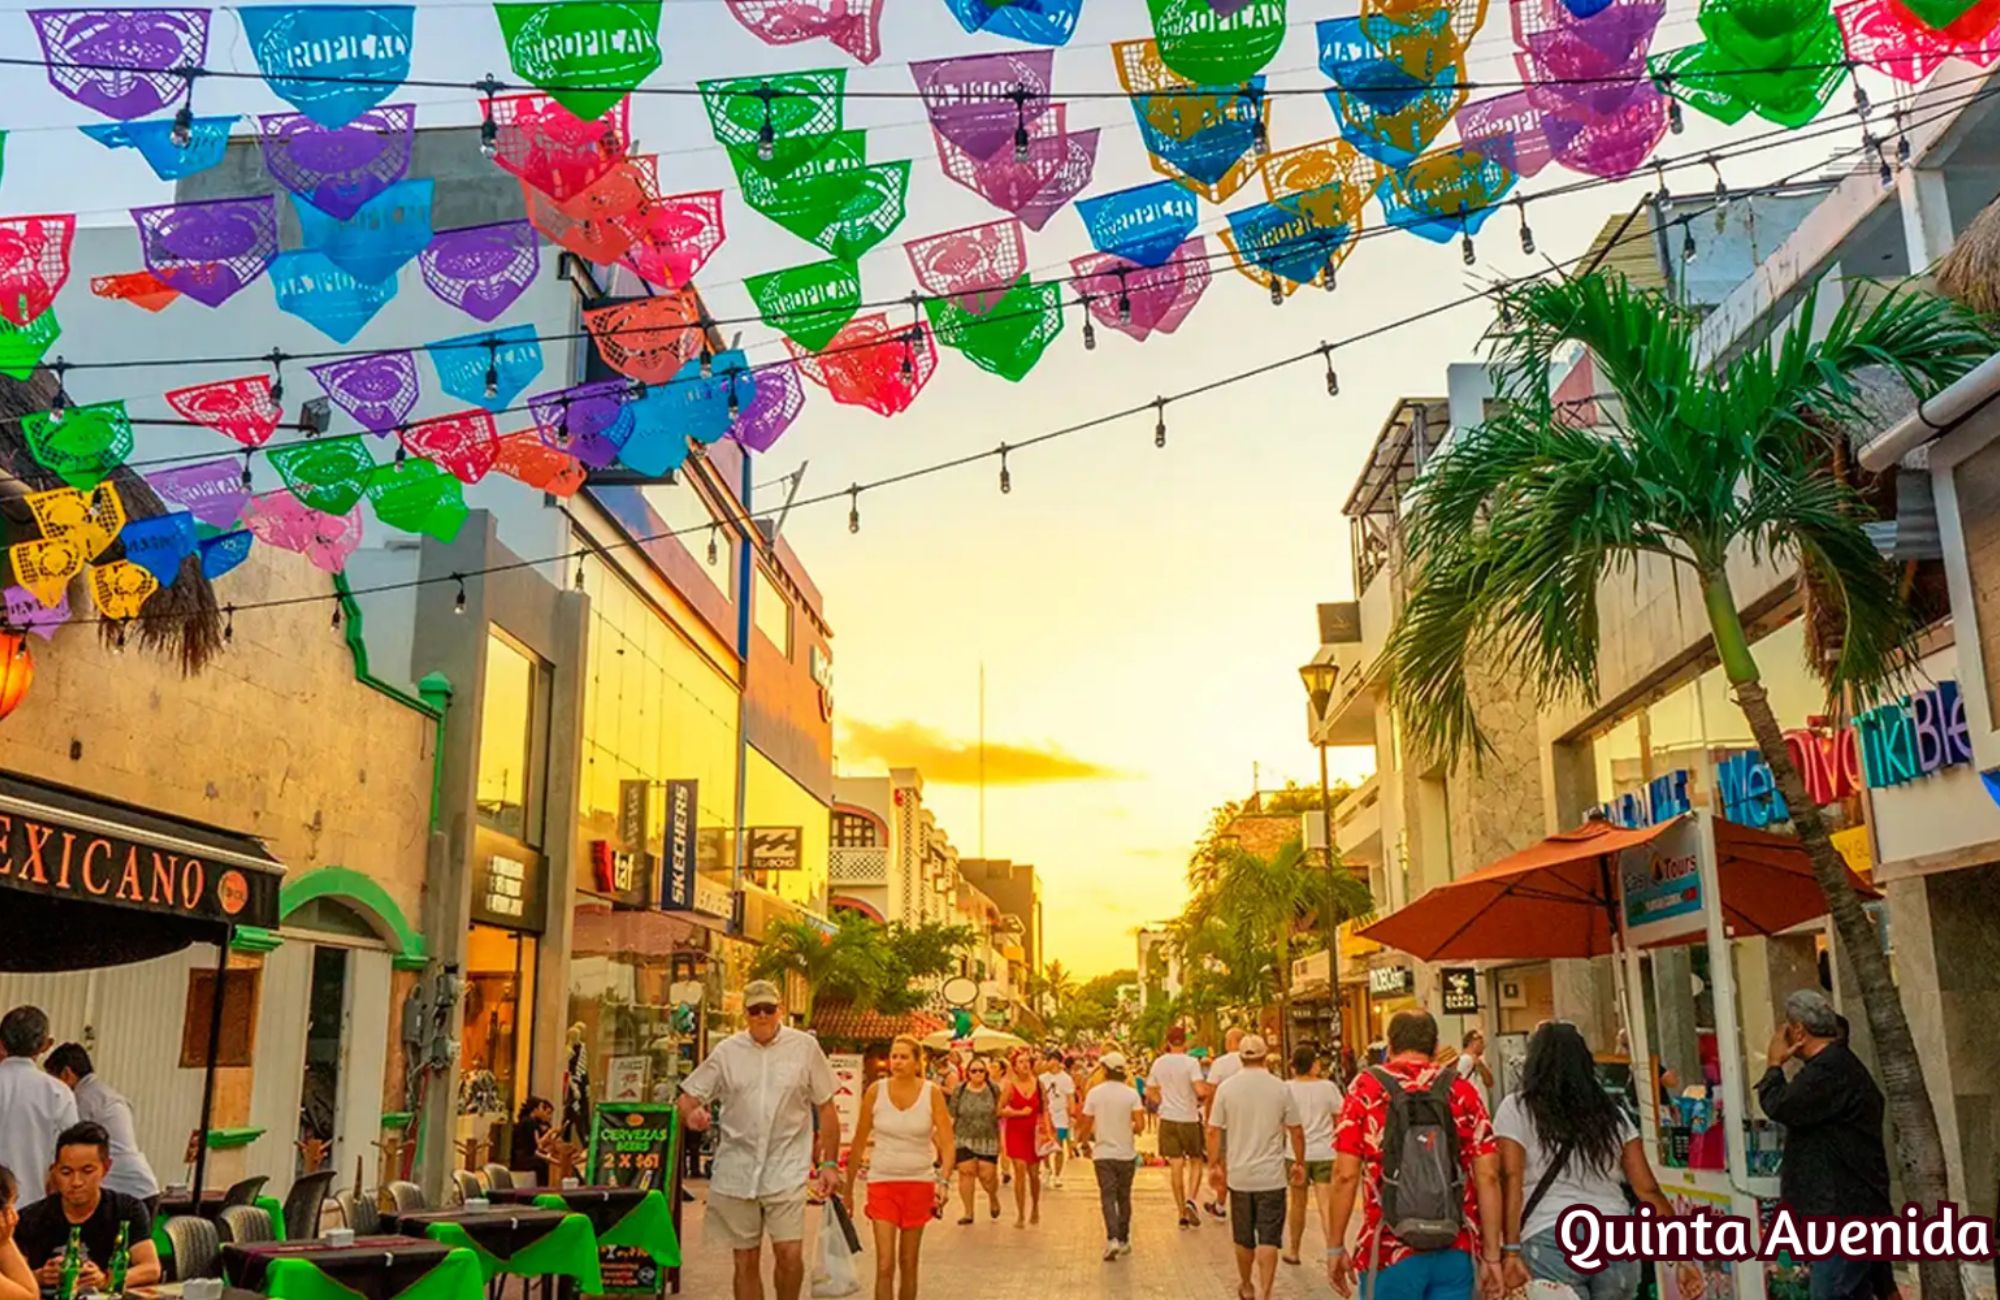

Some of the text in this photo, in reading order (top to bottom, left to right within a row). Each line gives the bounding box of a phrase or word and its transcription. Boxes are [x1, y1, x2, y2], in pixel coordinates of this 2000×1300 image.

[672, 784, 689, 906] SKECHERS
[1664, 855, 1698, 880] Tours
[603, 1153, 615, 1168] 2
